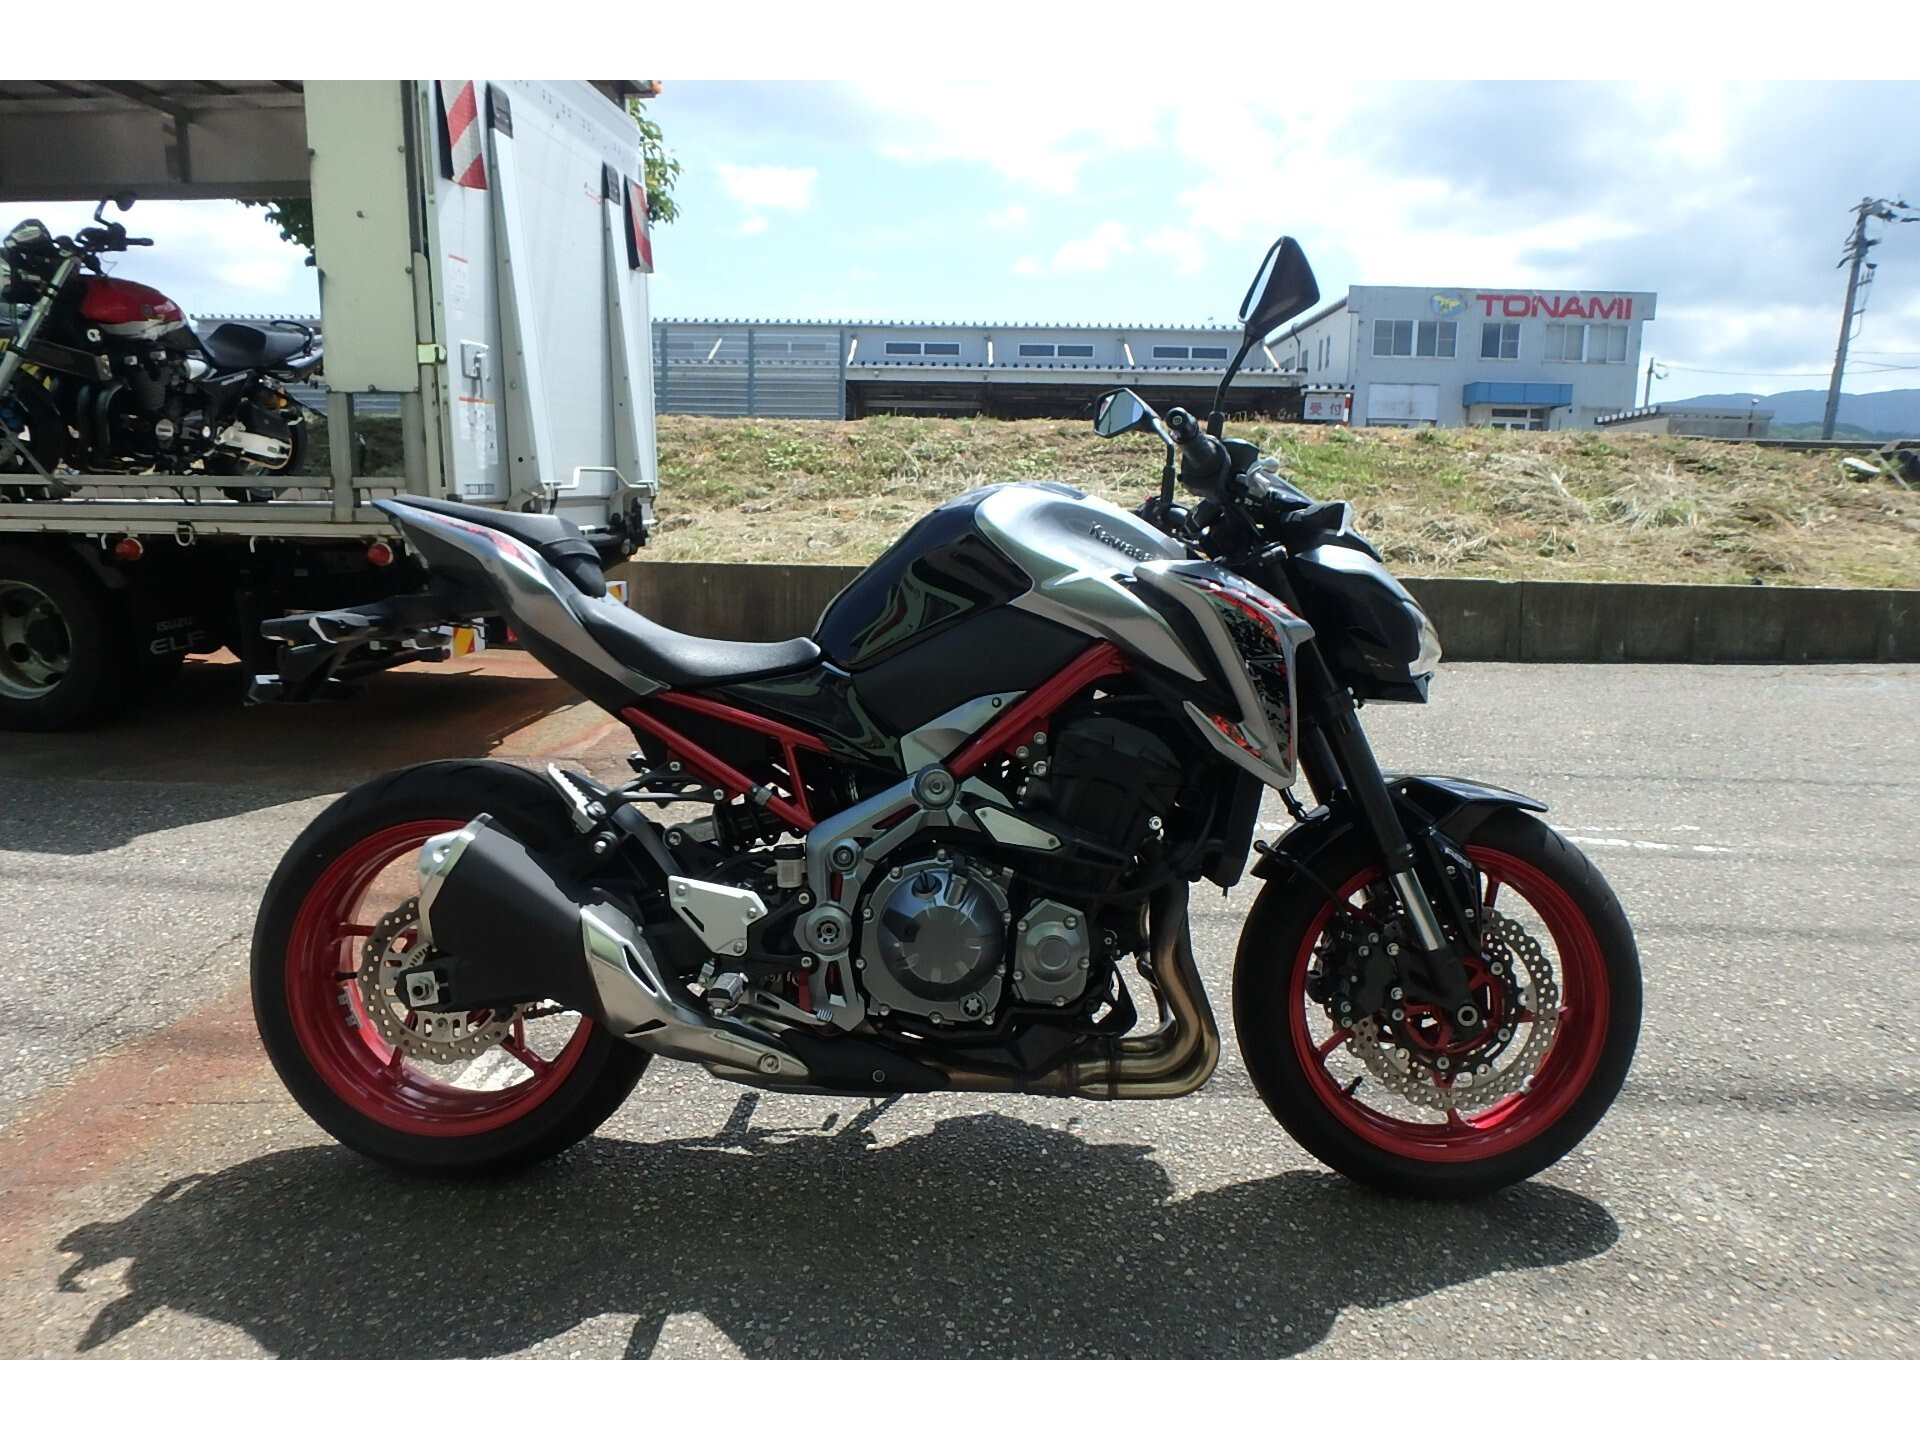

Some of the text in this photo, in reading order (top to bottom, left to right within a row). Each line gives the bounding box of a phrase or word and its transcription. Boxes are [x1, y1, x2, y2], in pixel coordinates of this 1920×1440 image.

[1476, 294, 1632, 320] TONAMI
[1310, 402, 1342, 416] 受付
[156, 616, 193, 632] ISUZU
[149, 630, 206, 655] ELF
